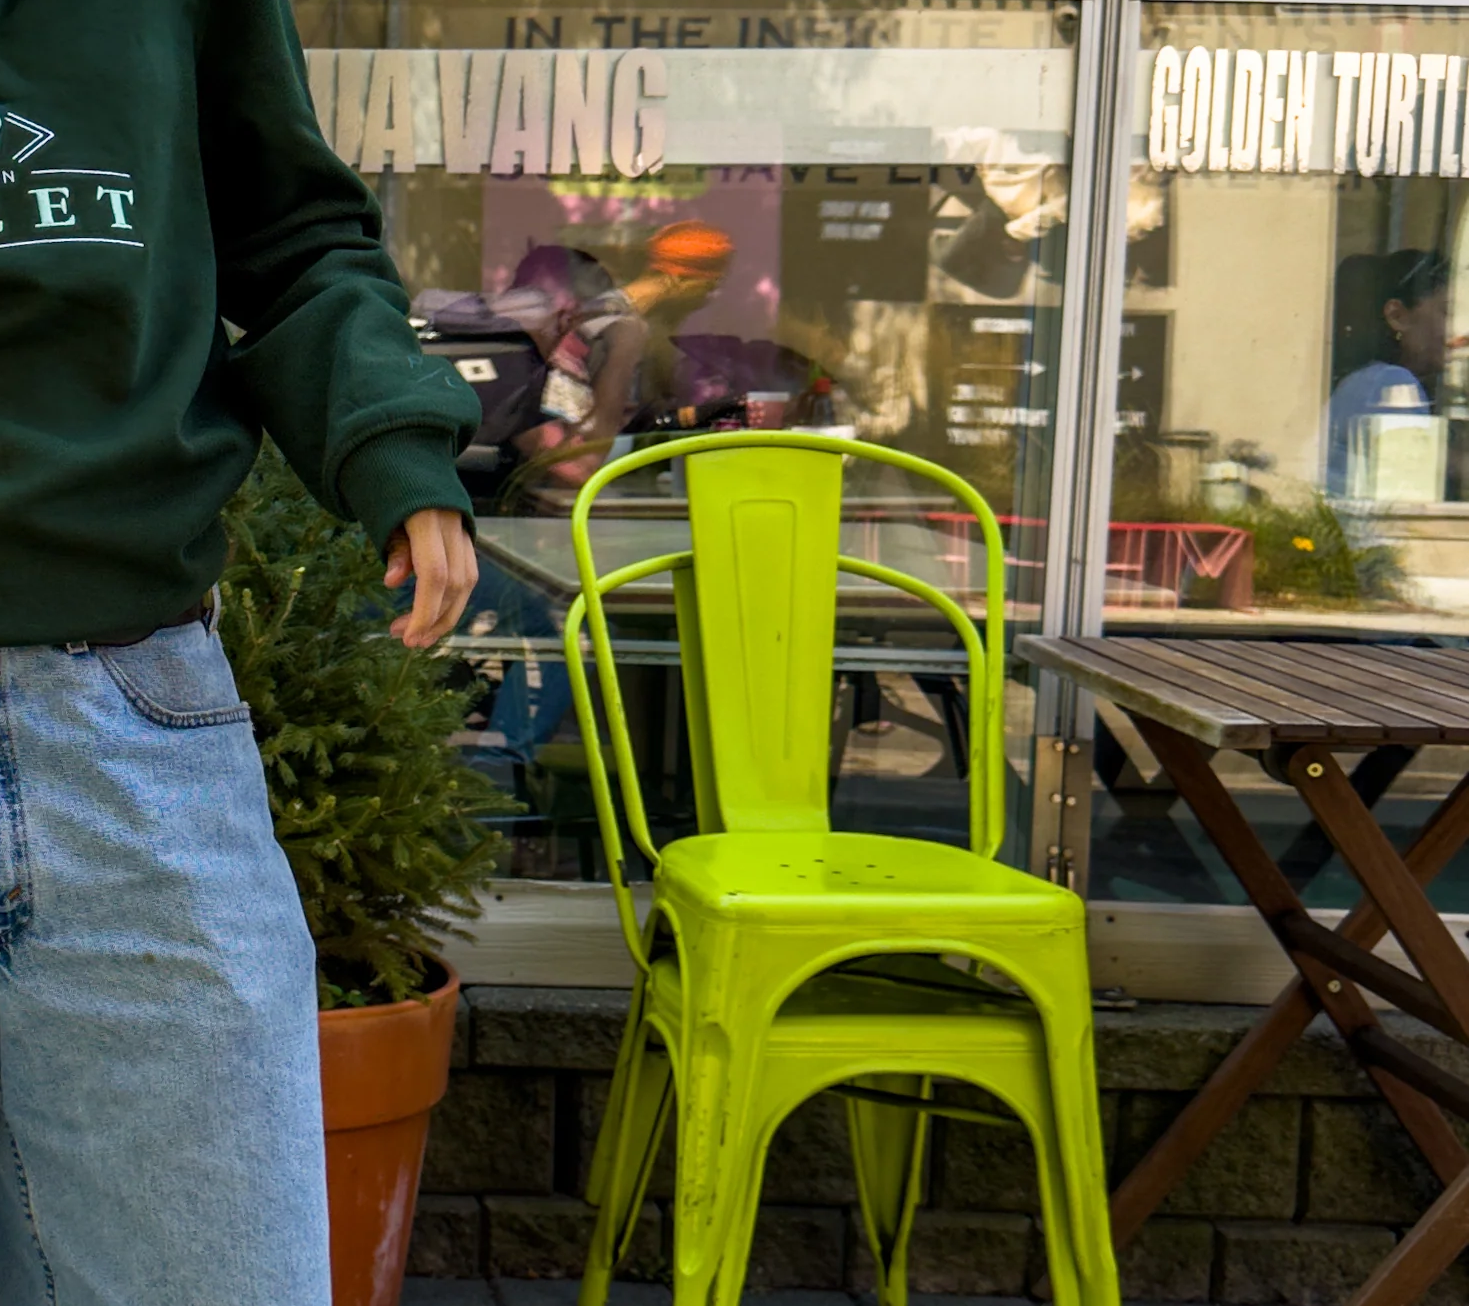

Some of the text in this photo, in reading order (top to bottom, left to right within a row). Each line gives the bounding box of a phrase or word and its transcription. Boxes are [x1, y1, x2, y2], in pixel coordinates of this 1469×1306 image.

[504, 15, 564, 49] IN
[592, 15, 712, 49] THE
[437, 47, 669, 179] VANG
[1148, 44, 1318, 173] GOLDEN
